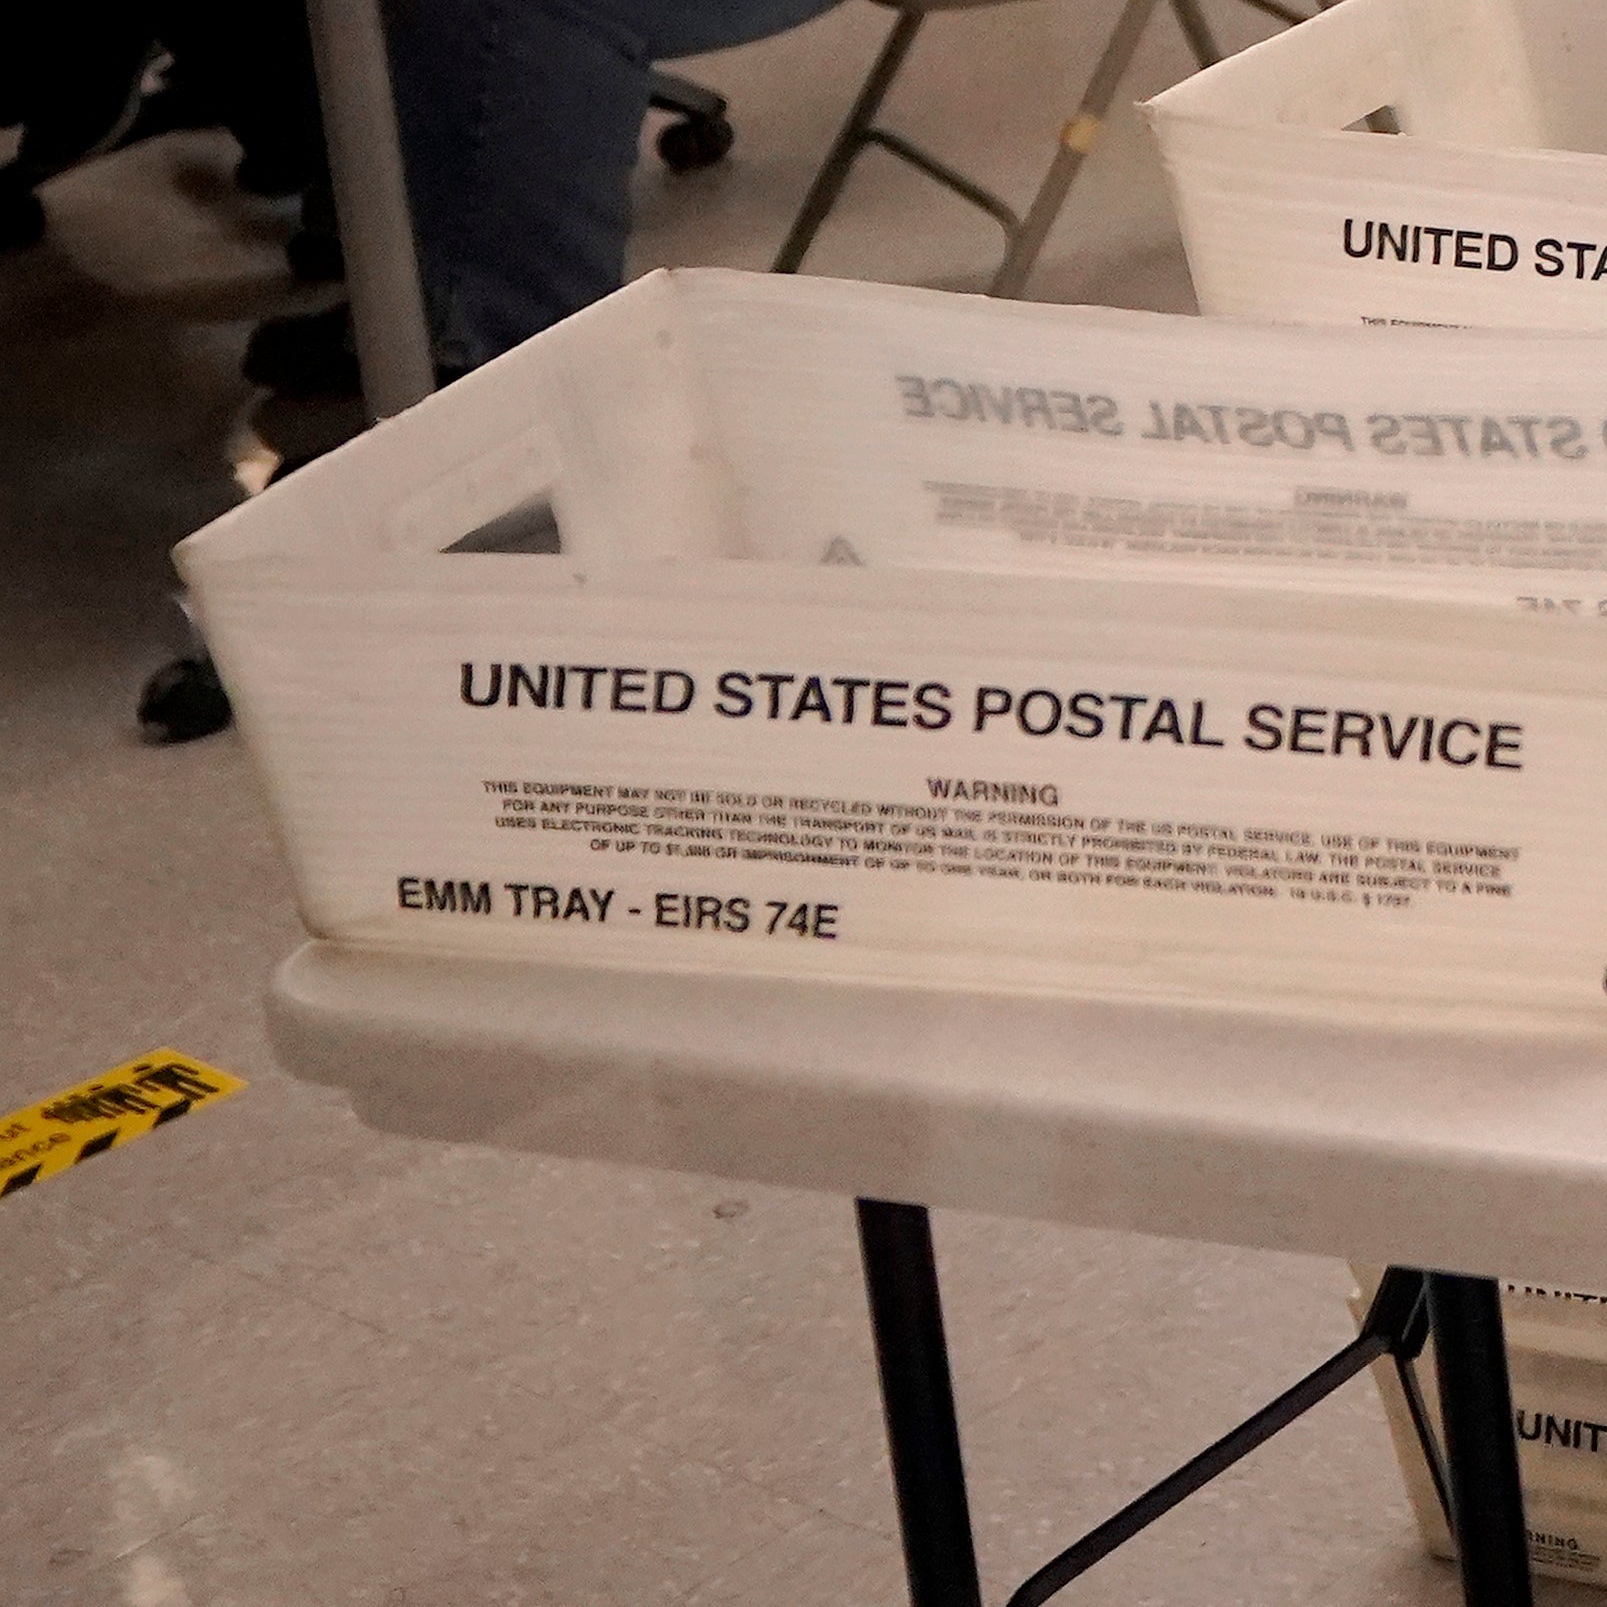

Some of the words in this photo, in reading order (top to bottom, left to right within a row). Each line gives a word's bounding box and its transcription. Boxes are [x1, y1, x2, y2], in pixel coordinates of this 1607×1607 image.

[1342, 218, 1521, 272] UNITED
[459, 662, 695, 713] UNITED
[713, 672, 953, 731] STATES
[972, 686, 1225, 748] POSTAL
[1243, 702, 1523, 771] SERVICE
[483, 779, 517, 793] THIS
[523, 781, 613, 799] EQUIPMENT
[926, 776, 1059, 807] WARNING
[540, 800, 570, 814] ANY
[575, 802, 649, 819] PURPOSE
[542, 818, 640, 836] ELECTRONIC
[615, 839, 635, 853] UP
[642, 841, 661, 855] TO
[398, 875, 493, 916] EMM
[503, 883, 616, 923] TRAY
[628, 906, 642, 917] -
[655, 892, 752, 934] EIRS
[764, 900, 840, 940] 74E
[1529, 1530, 1578, 1551] NING
